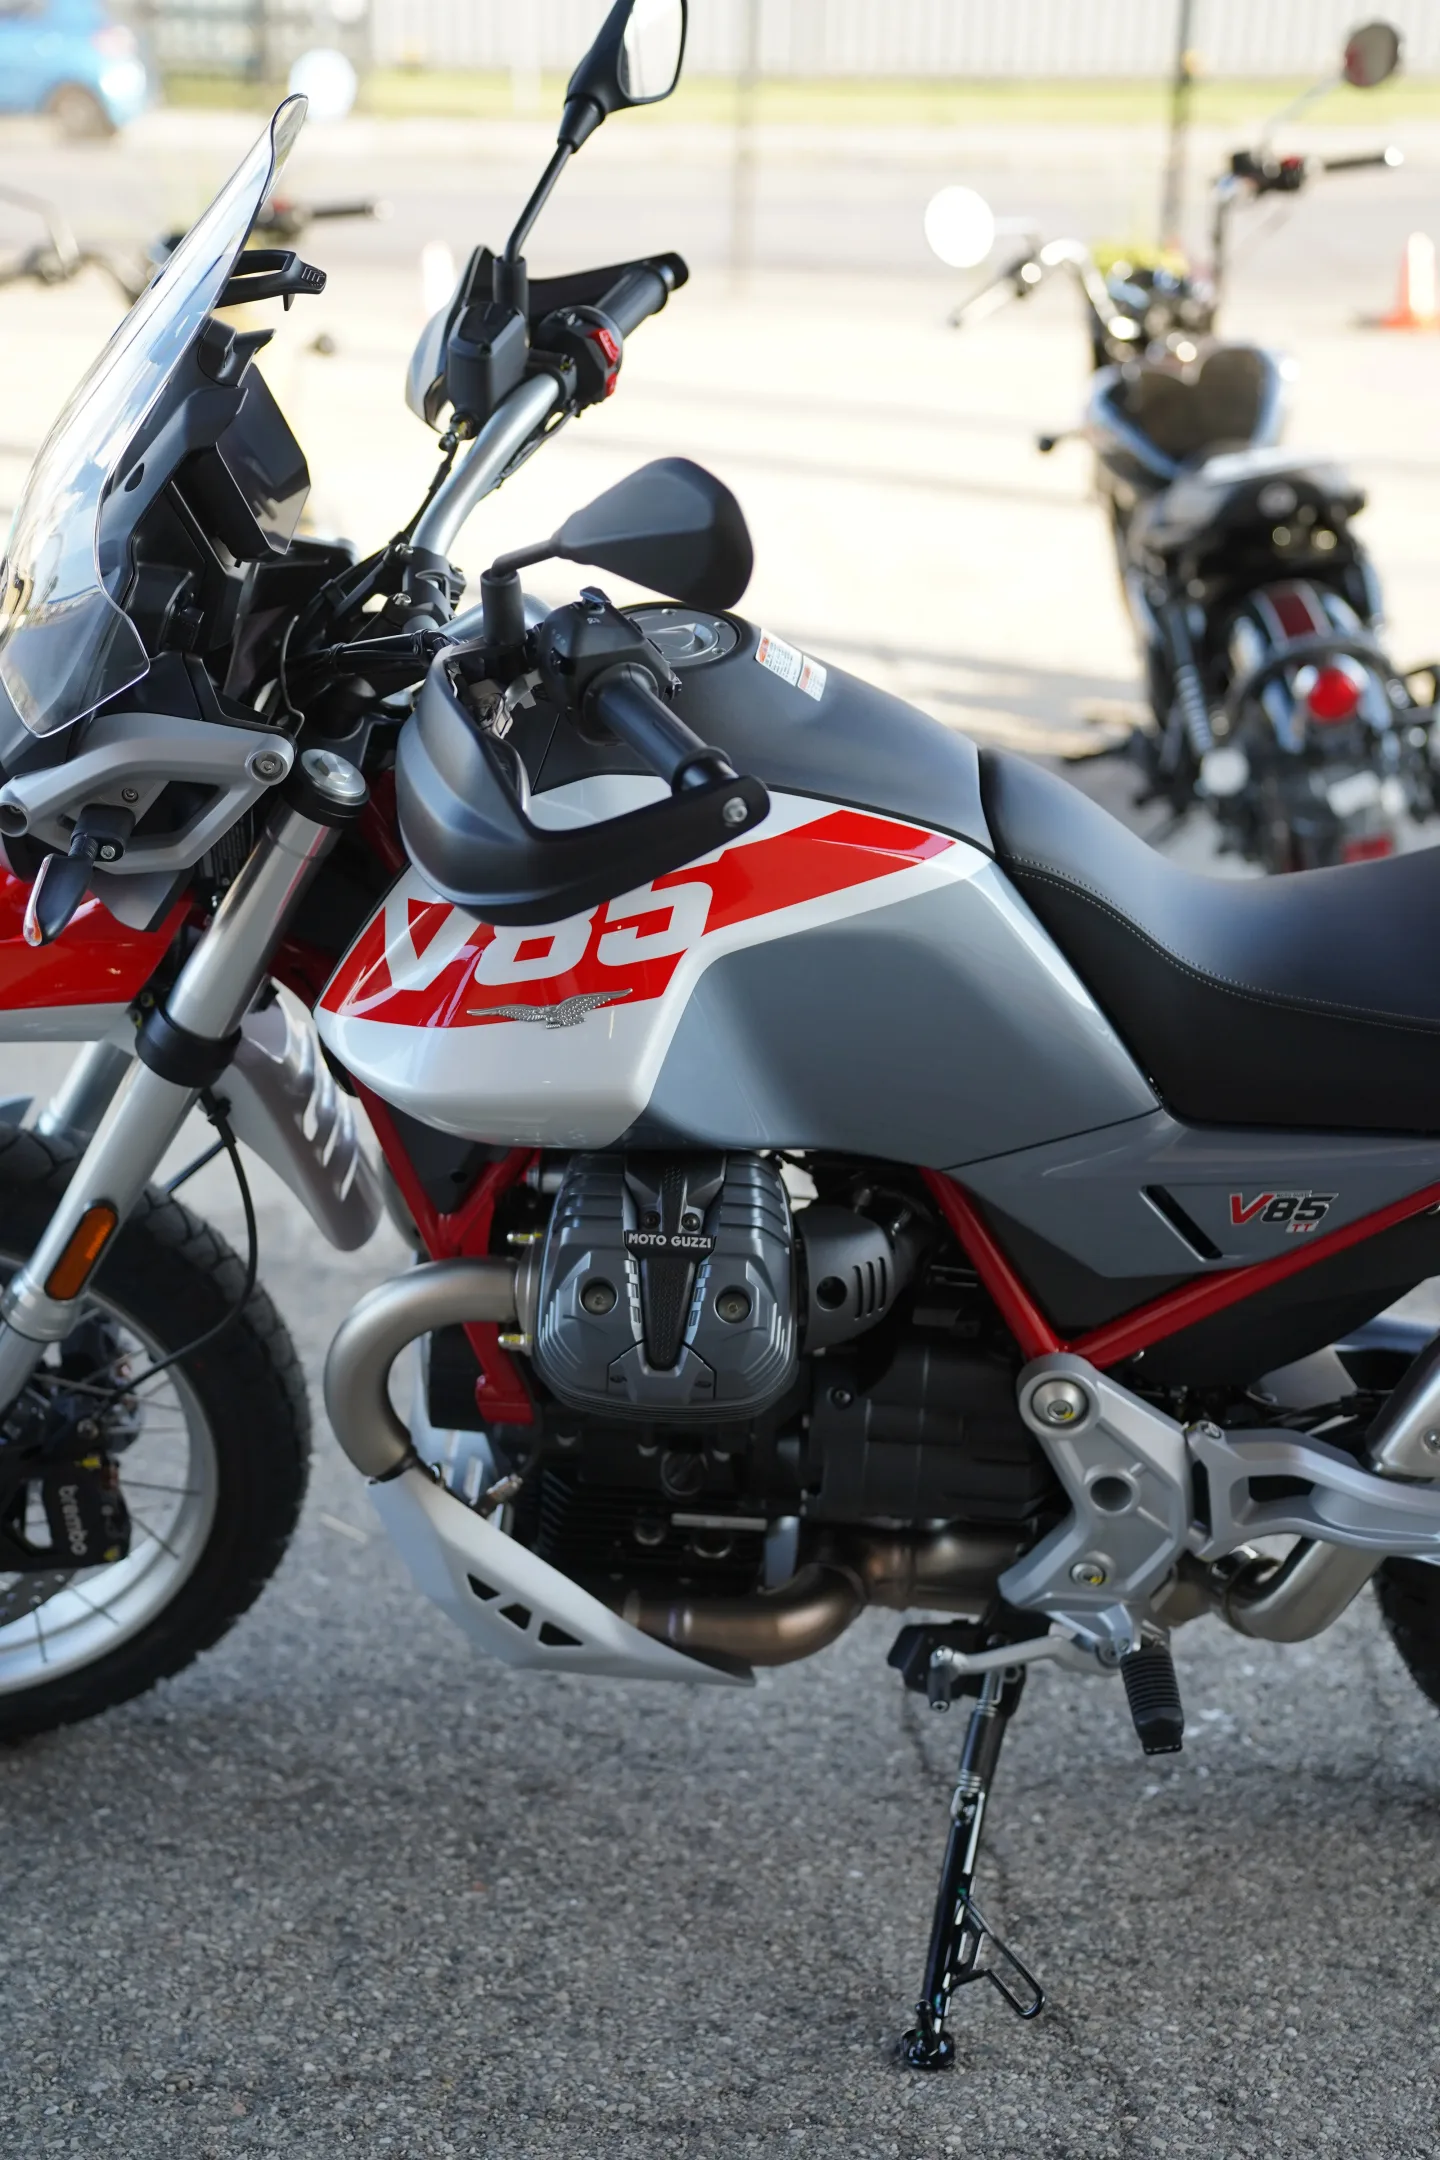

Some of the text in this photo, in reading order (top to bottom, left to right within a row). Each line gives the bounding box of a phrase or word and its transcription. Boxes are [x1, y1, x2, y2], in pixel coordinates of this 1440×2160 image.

[384, 850, 726, 991] V85
[1230, 1192, 1337, 1224] V85
[628, 1232, 712, 1249] MOTO GUZZI
[1291, 1223, 1313, 1232] TT
[59, 1484, 88, 1556] brembo
